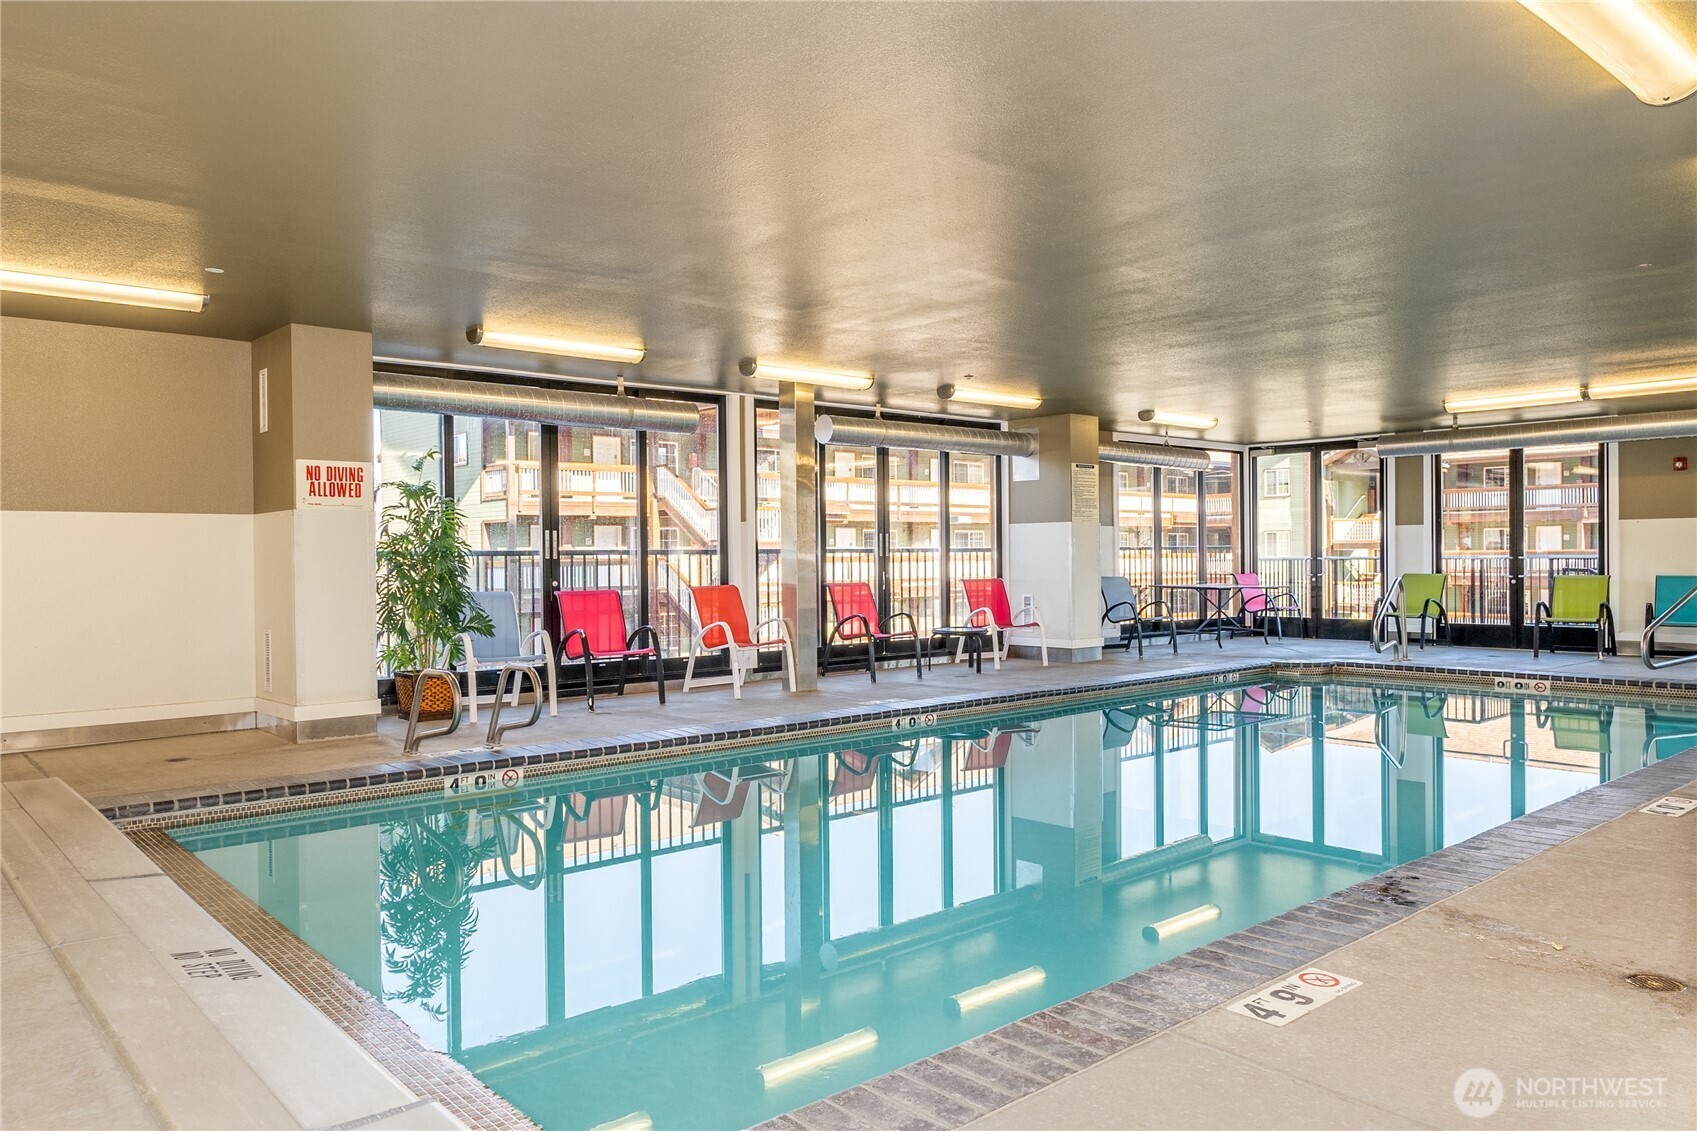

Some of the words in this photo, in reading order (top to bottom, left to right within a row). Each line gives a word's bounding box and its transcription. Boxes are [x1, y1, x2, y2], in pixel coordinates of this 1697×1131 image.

[306, 465, 320, 481] NO
[326, 466, 363, 482] DIVING
[309, 482, 361, 498] ALLOWED
[461, 776, 469, 784] FT
[170, 951, 204, 960] NO
[204, 947, 238, 957] NO
[181, 962, 223, 978] STEP
[215, 959, 262, 981] DIVING
[1281, 983, 1302, 992] IN
[1252, 997, 1271, 1006] FT
[1269, 989, 1314, 1006] 9
[1243, 1003, 1287, 1020] 4
